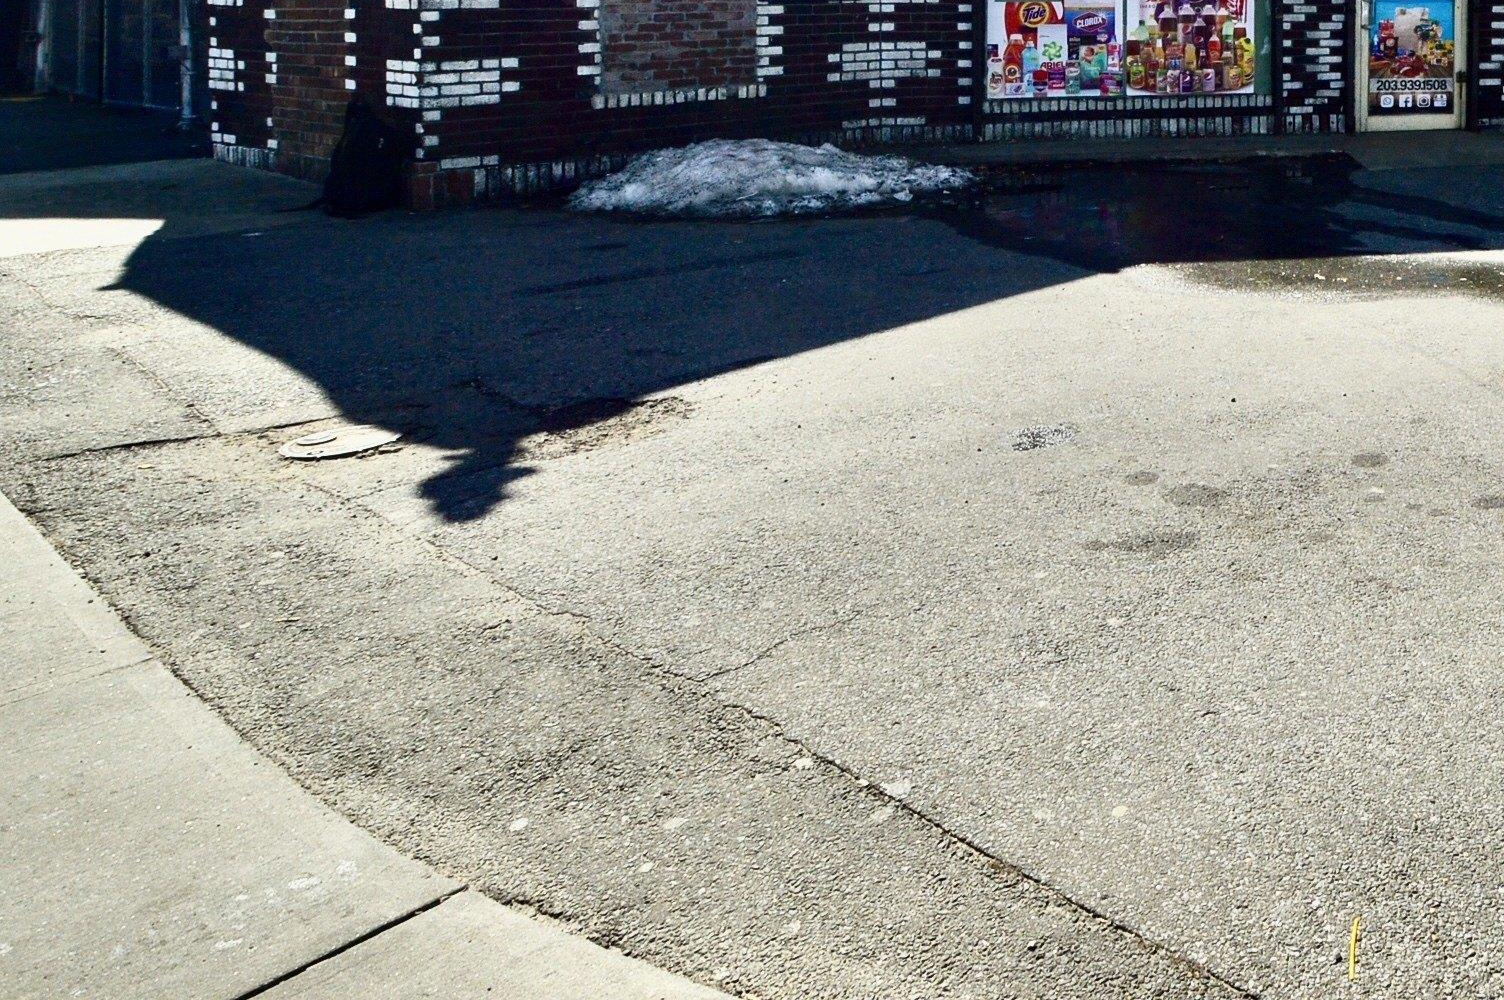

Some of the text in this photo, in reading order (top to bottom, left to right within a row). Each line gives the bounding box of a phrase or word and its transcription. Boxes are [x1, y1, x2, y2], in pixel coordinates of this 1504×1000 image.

[1023, 6, 1047, 23] Tide
[1076, 16, 1104, 29] CLOROX
[1040, 61, 1065, 70] ARIEL
